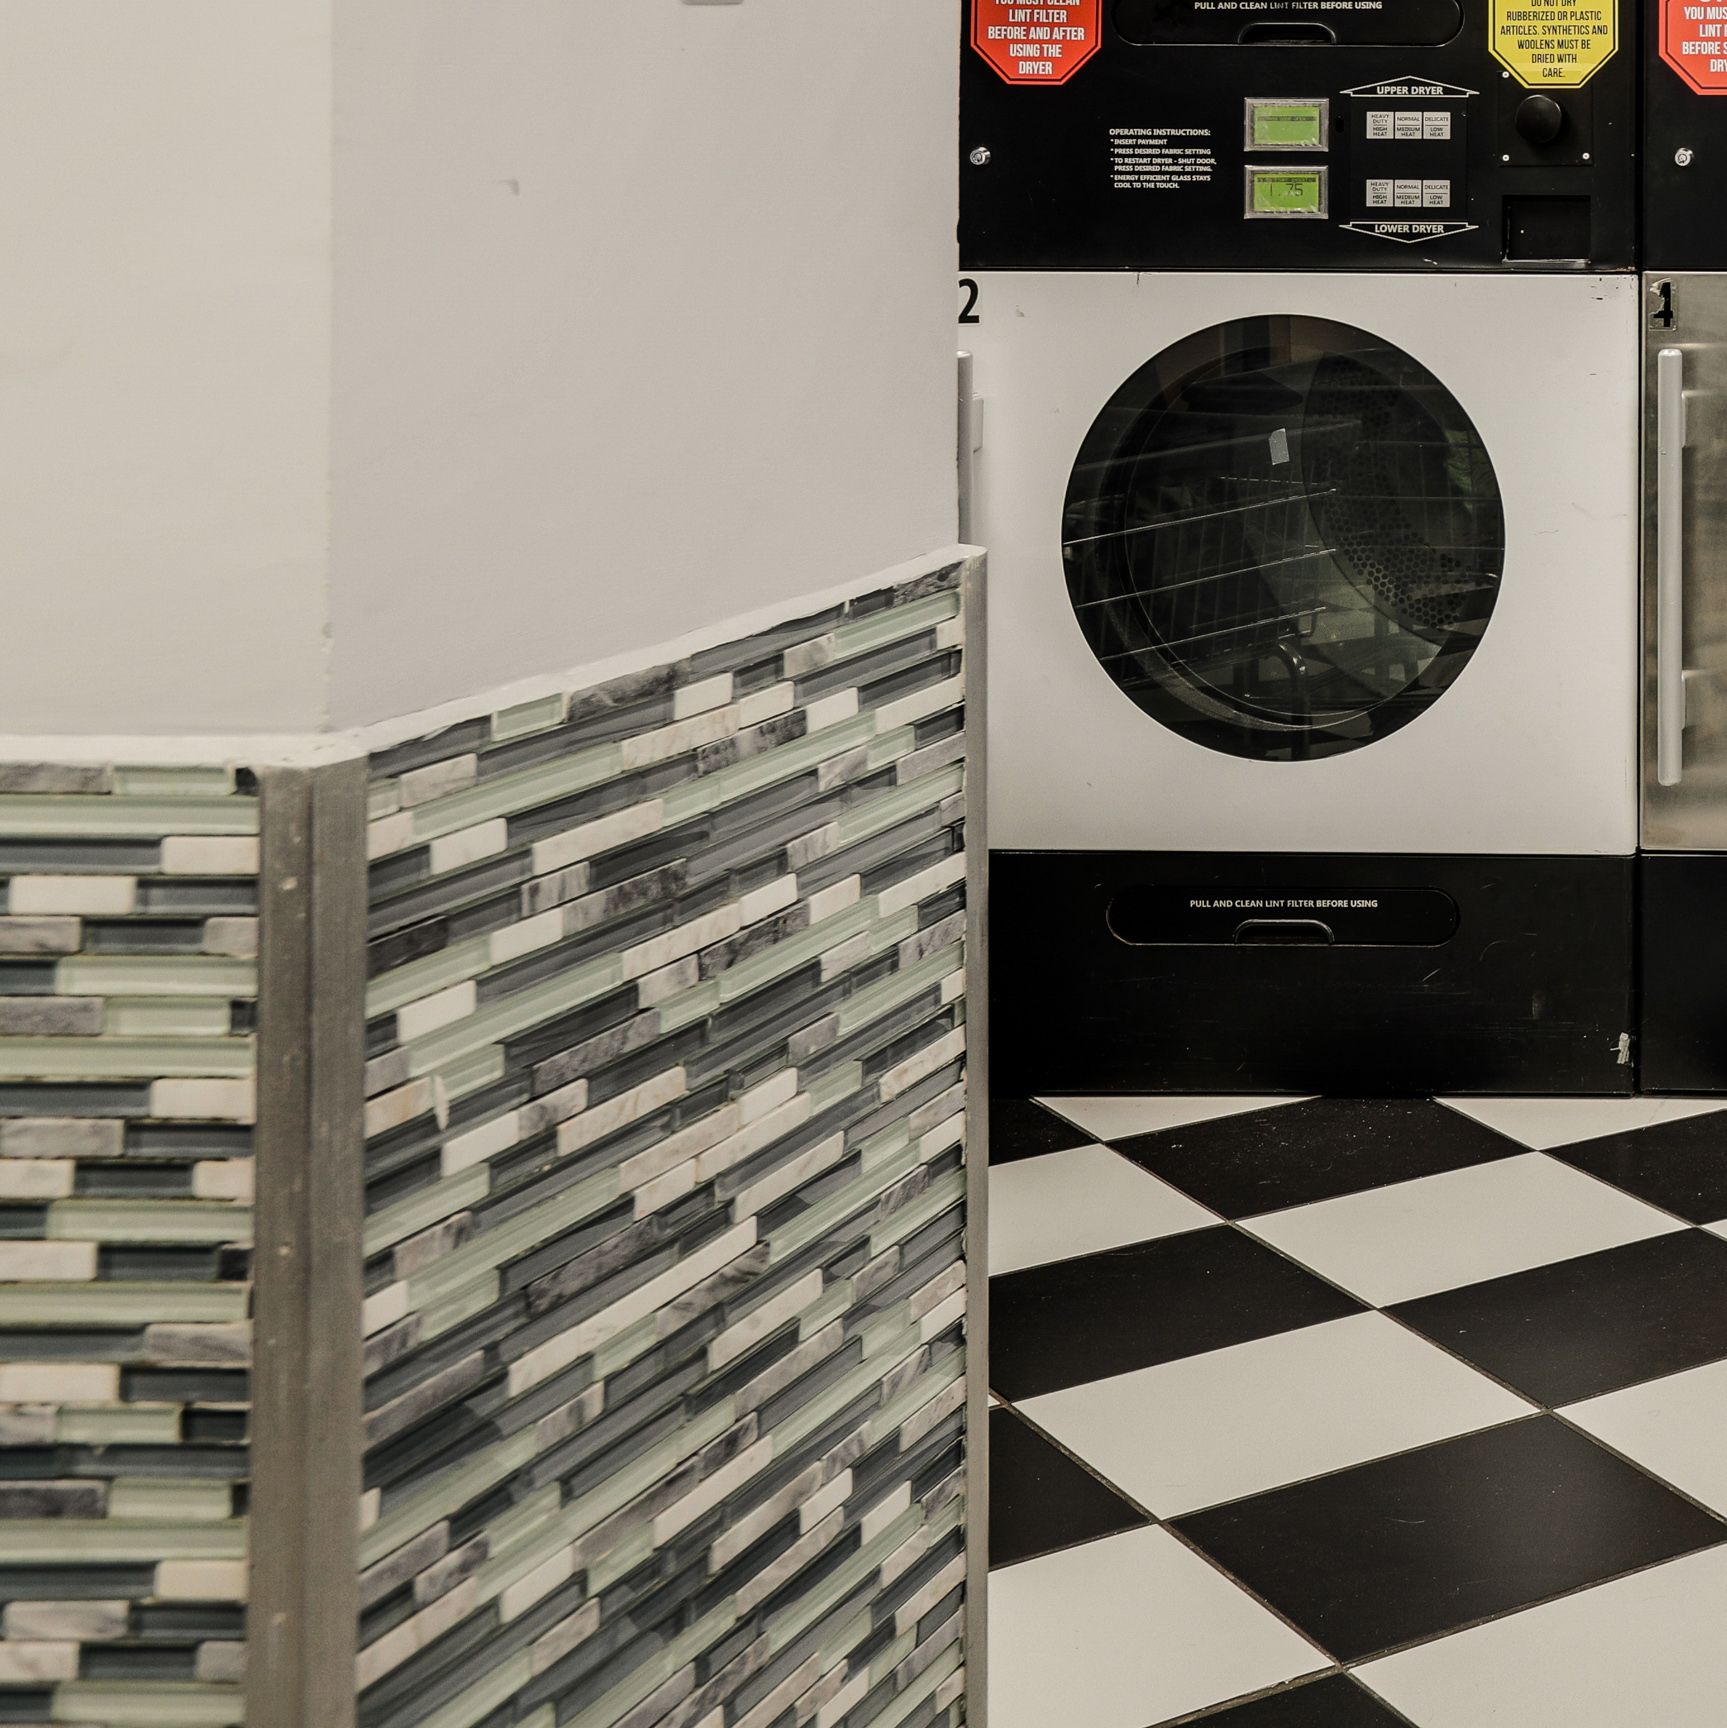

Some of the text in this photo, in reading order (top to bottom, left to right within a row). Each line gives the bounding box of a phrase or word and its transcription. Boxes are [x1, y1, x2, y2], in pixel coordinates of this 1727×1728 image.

[1506, 10, 1603, 22] RUBBERIZED OR PLASTIC
[1683, 6, 1705, 21] YOU
[1500, 24, 1609, 36] ARTICLES. SYNTHETICS AND
[1699, 23, 1723, 38] LINT
[1517, 39, 1592, 50] WOOLENS MUST BE
[1681, 41, 1722, 55] BEFORE
[1531, 53, 1578, 64] DRIED WITH
[1542, 67, 1566, 79] CARE.
[957, 278, 980, 325] 2
